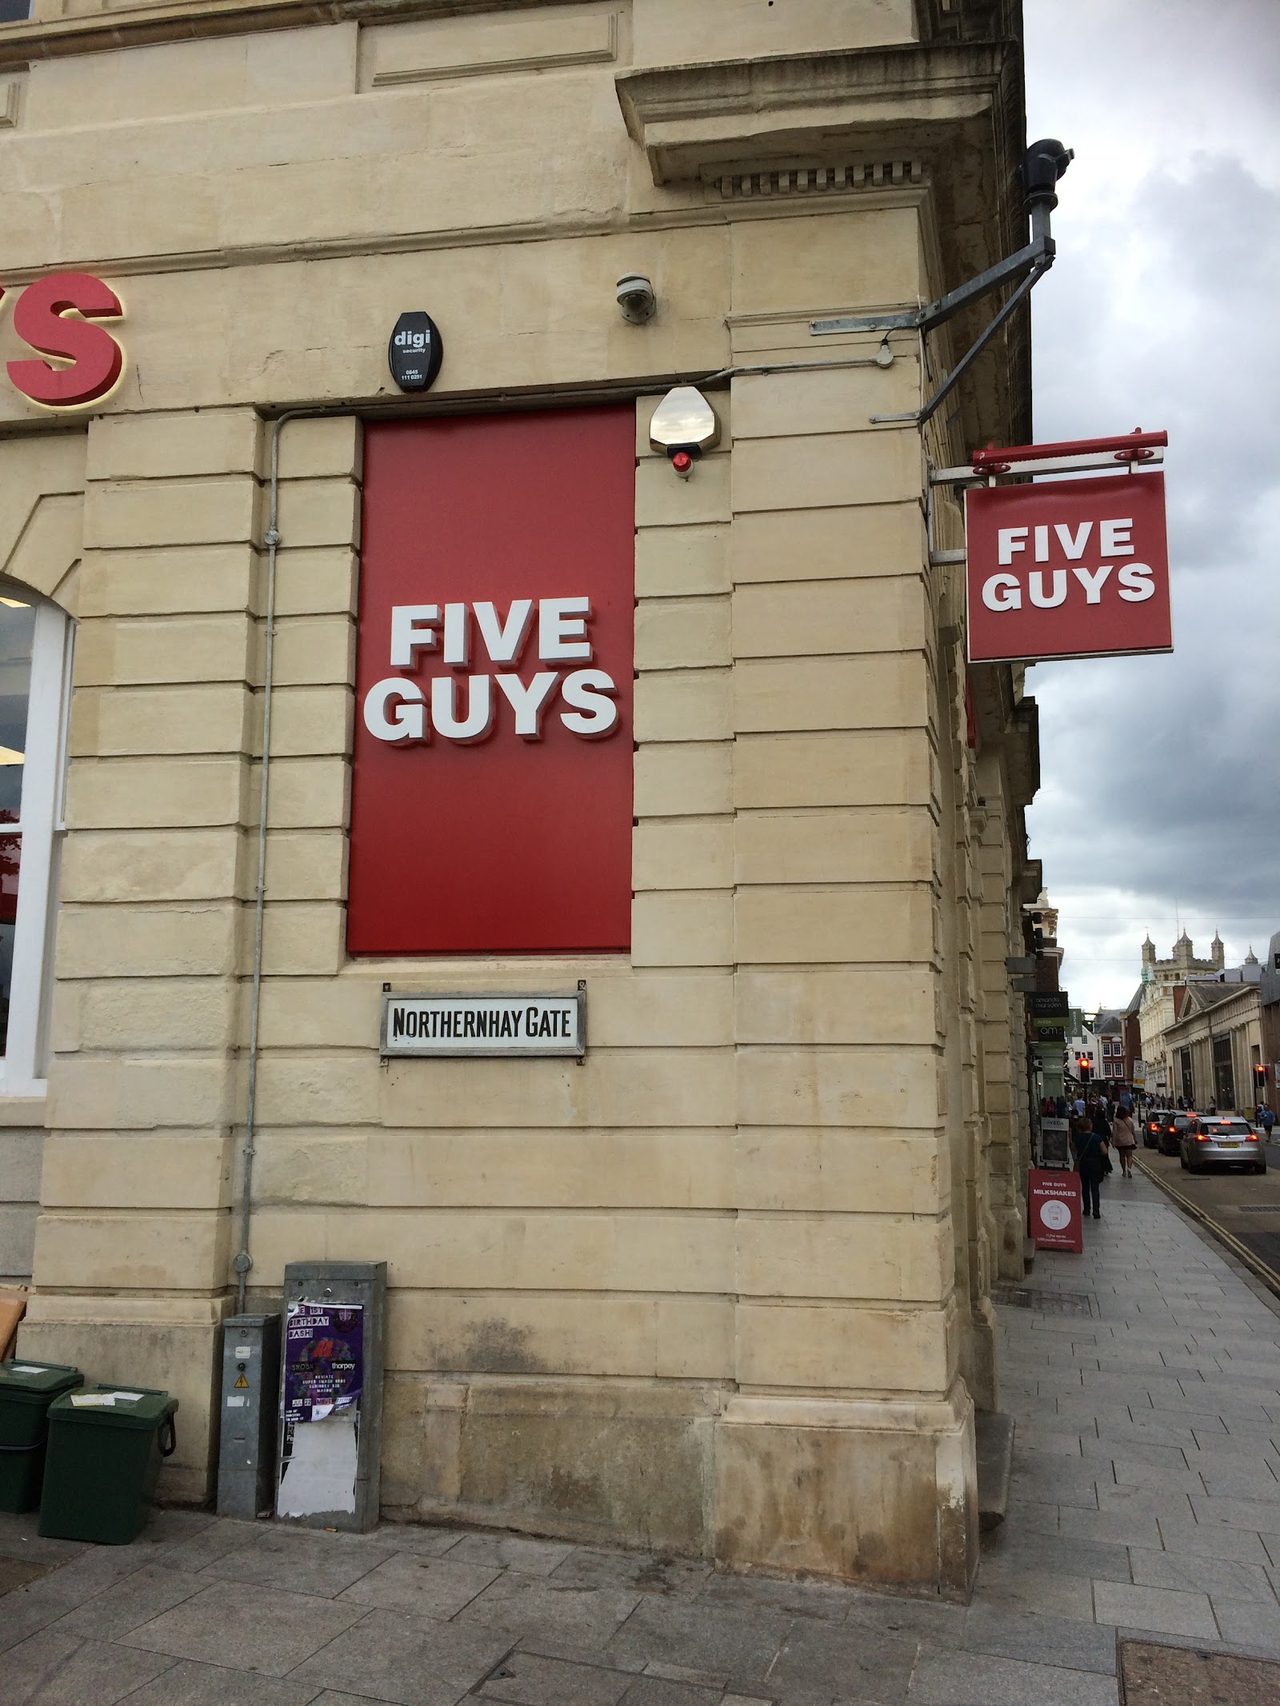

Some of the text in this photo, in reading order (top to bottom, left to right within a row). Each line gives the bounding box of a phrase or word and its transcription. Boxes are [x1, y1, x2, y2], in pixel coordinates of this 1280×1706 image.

[394, 329, 431, 348] digi
[998, 517, 1135, 566] FIVE
[981, 562, 1156, 612] GUYS
[390, 596, 593, 669] FIVE
[363, 668, 619, 743] GUYS
[393, 1006, 572, 1038] NORTHERNHAY GATE
[1033, 1188, 1077, 1197] MILKSHAKES
